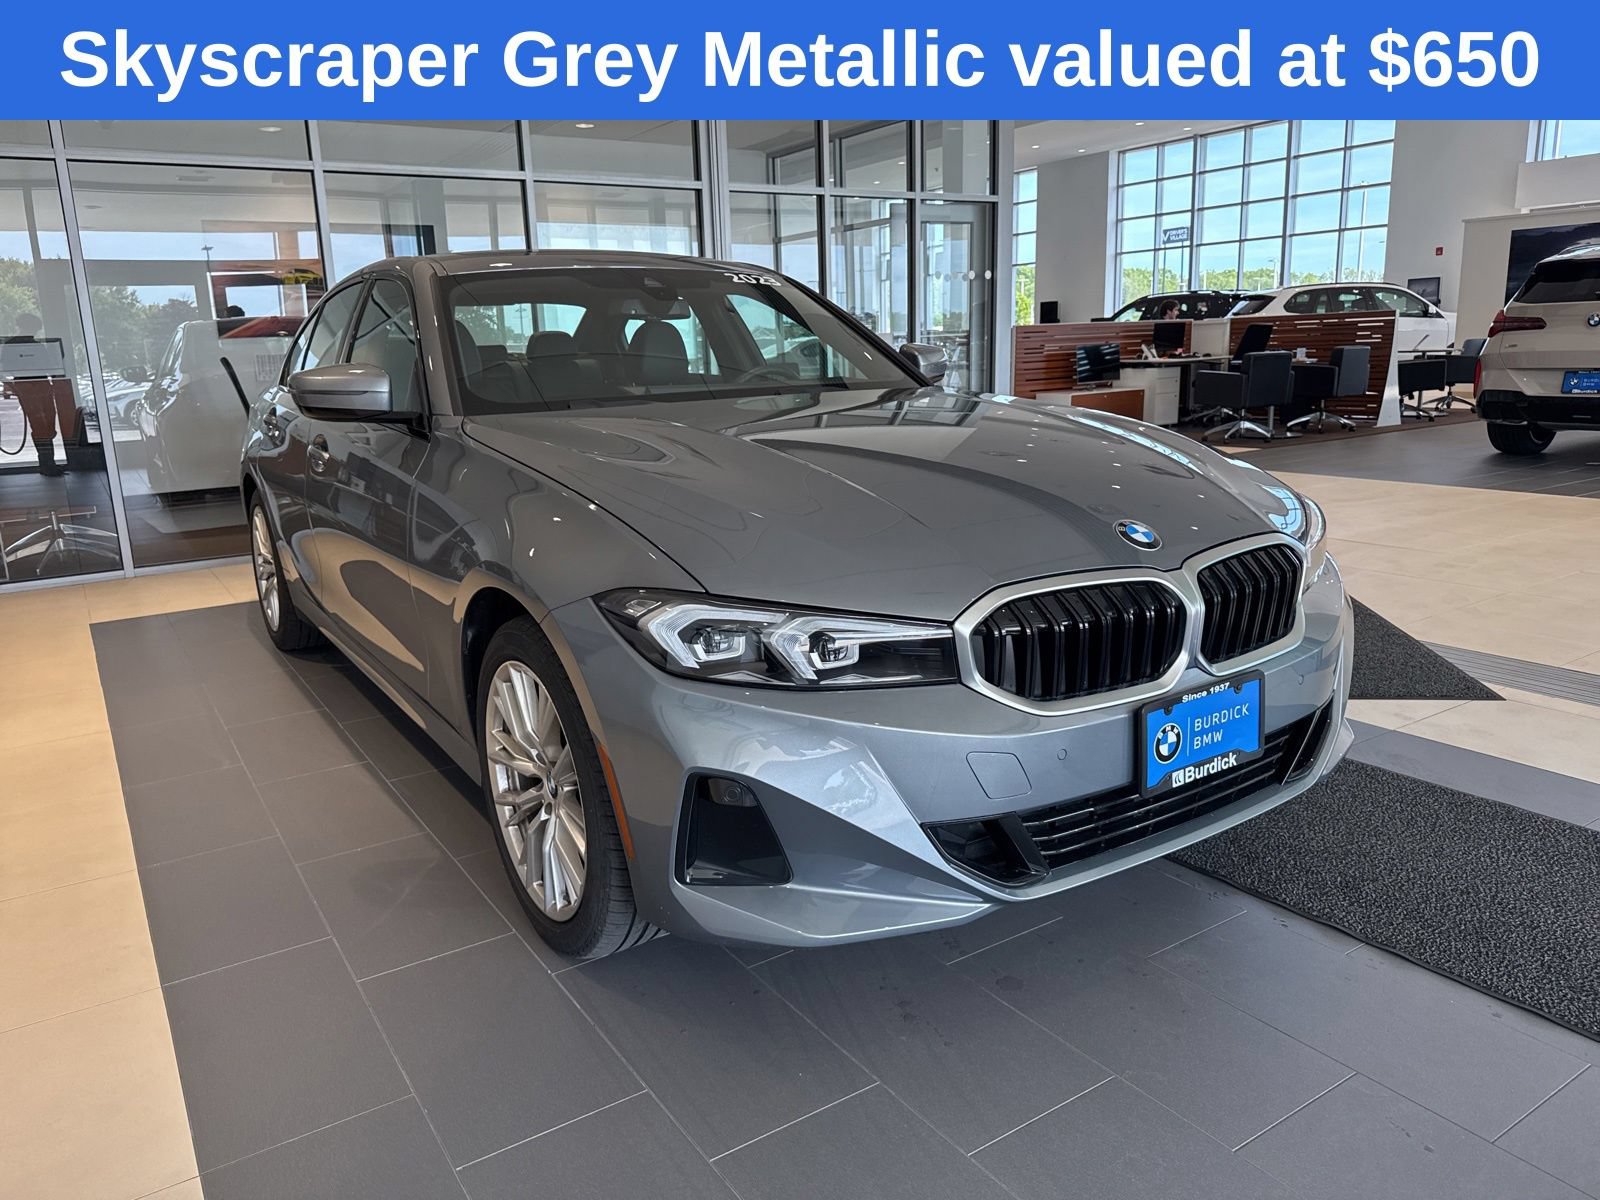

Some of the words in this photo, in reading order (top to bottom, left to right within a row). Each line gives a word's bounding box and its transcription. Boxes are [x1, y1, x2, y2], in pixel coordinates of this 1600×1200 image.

[724, 273, 782, 286] 2023
[1182, 690, 1207, 703] Since
[1210, 682, 1230, 694] 1937
[1194, 703, 1249, 732] BURDICK
[1193, 729, 1223, 750] BMW
[1185, 753, 1237, 781] Burdick
